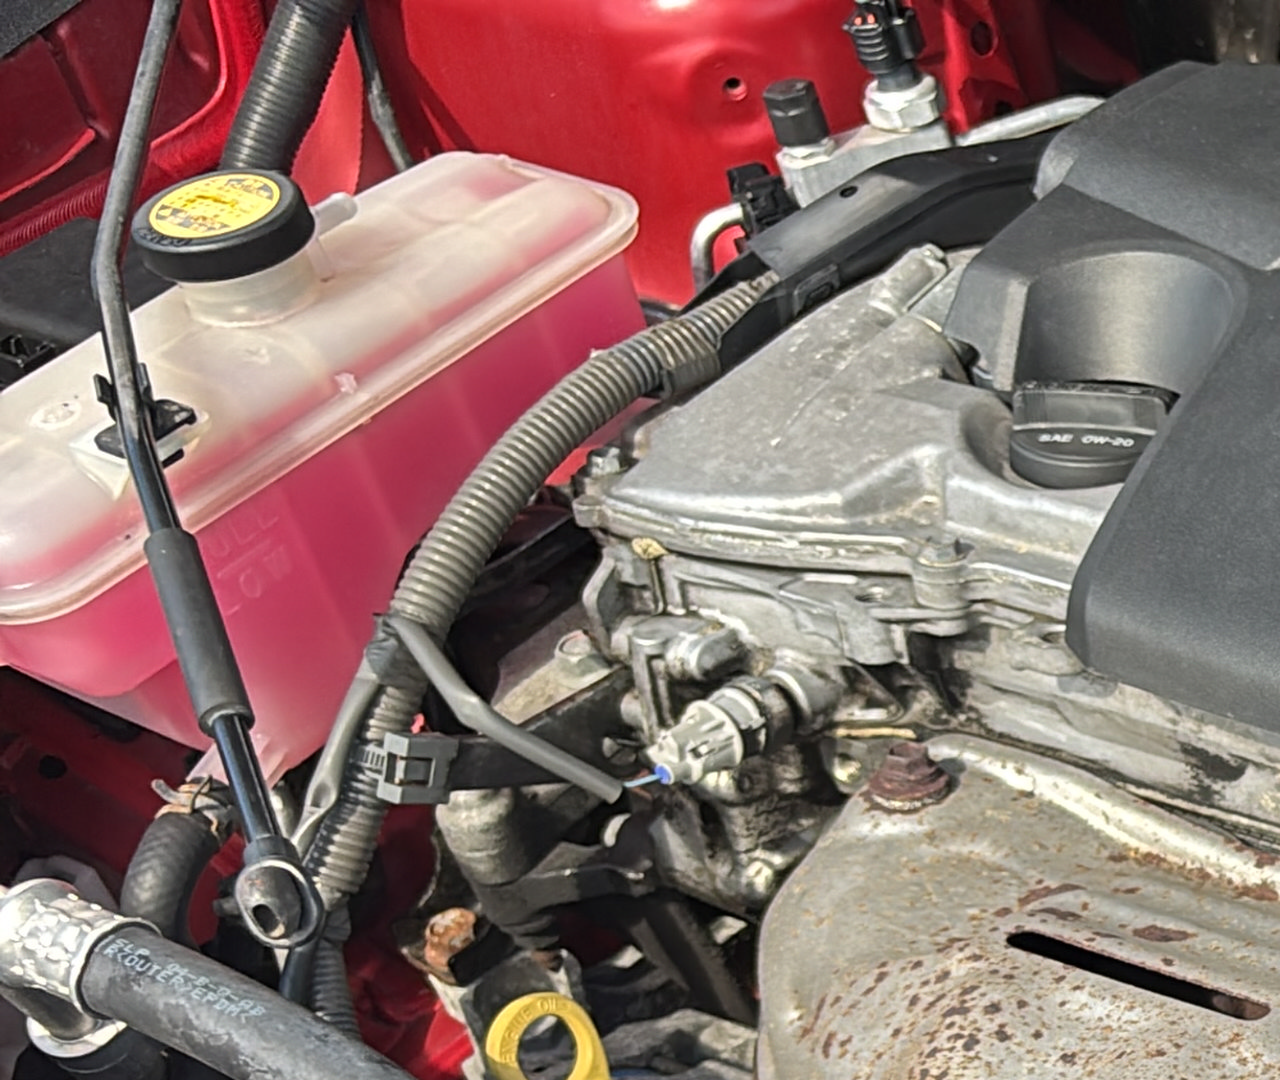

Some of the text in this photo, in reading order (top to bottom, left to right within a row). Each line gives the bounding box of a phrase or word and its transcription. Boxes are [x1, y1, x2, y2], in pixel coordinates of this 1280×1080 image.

[1038, 433, 1135, 448] SAE 0W-20
[537, 998, 557, 1012] OIL
